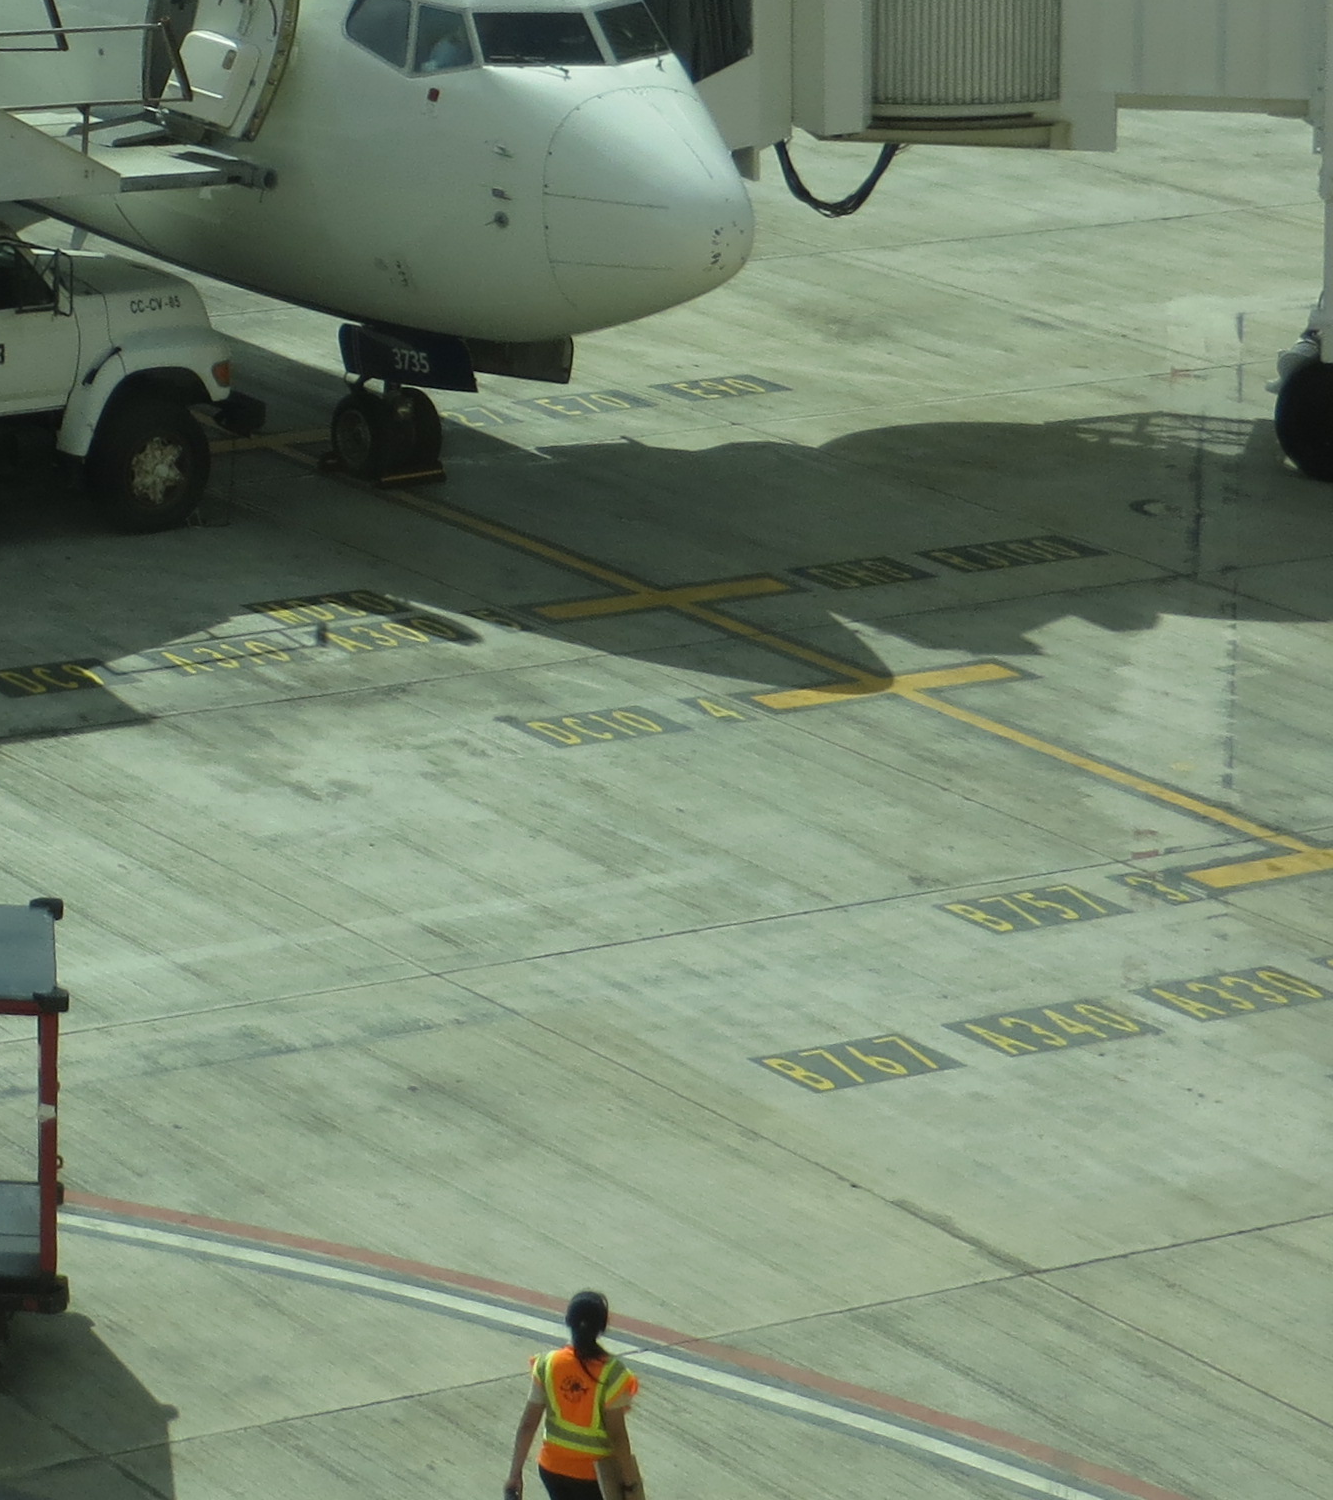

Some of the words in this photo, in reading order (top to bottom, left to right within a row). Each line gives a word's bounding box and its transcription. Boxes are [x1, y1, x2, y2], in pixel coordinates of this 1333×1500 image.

[393, 348, 431, 373] 3735
[537, 393, 631, 416] E70
[673, 377, 766, 400] E90
[161, 640, 291, 674] A310
[526, 709, 663, 745] DC10
[696, 698, 746, 721] 4
[944, 884, 1107, 931] B757
[762, 1035, 939, 1091] B767
[964, 1003, 1141, 1054] A340
[1151, 970, 1323, 1019] A330
